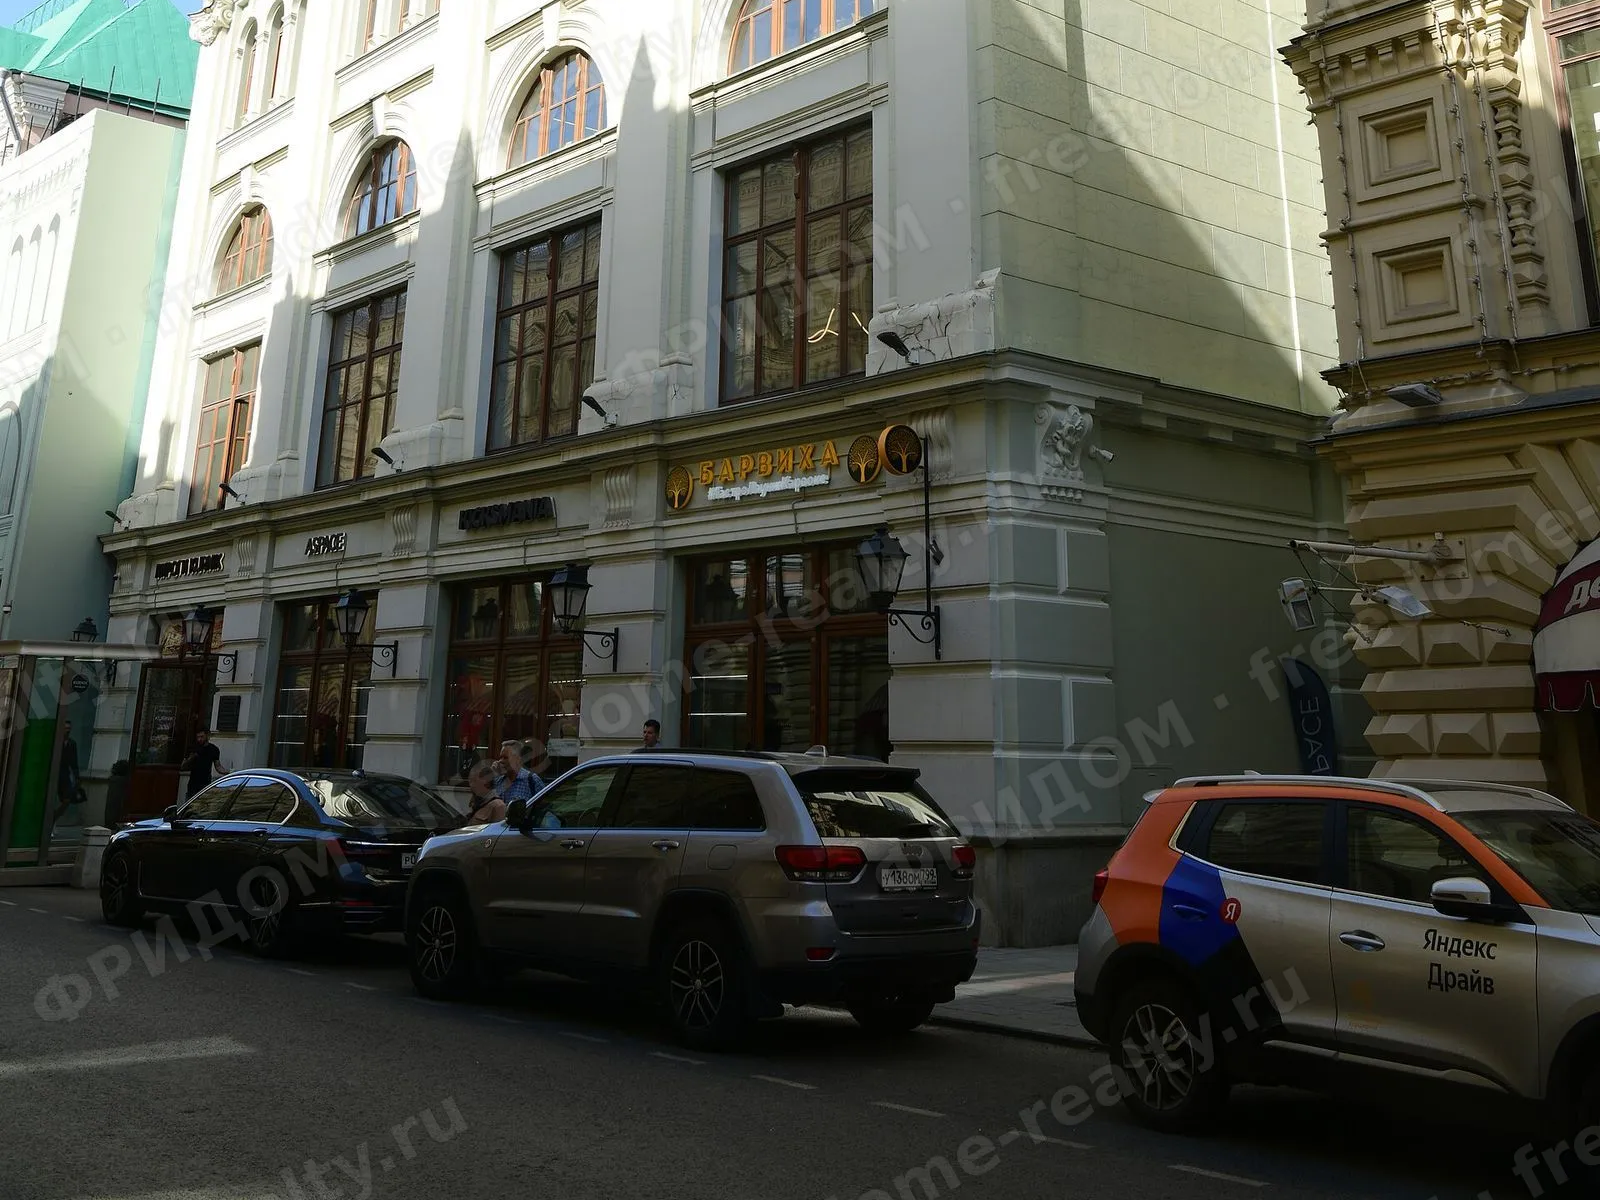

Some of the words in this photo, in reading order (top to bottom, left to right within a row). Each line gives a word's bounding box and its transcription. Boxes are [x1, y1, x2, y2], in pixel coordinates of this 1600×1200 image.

[699, 440, 840, 485] БАРВИХА
[305, 532, 346, 556] ASPACE
[1223, 901, 1236, 921] Я
[1422, 928, 1498, 960] Яндекс
[1427, 962, 1495, 995] Драйв
